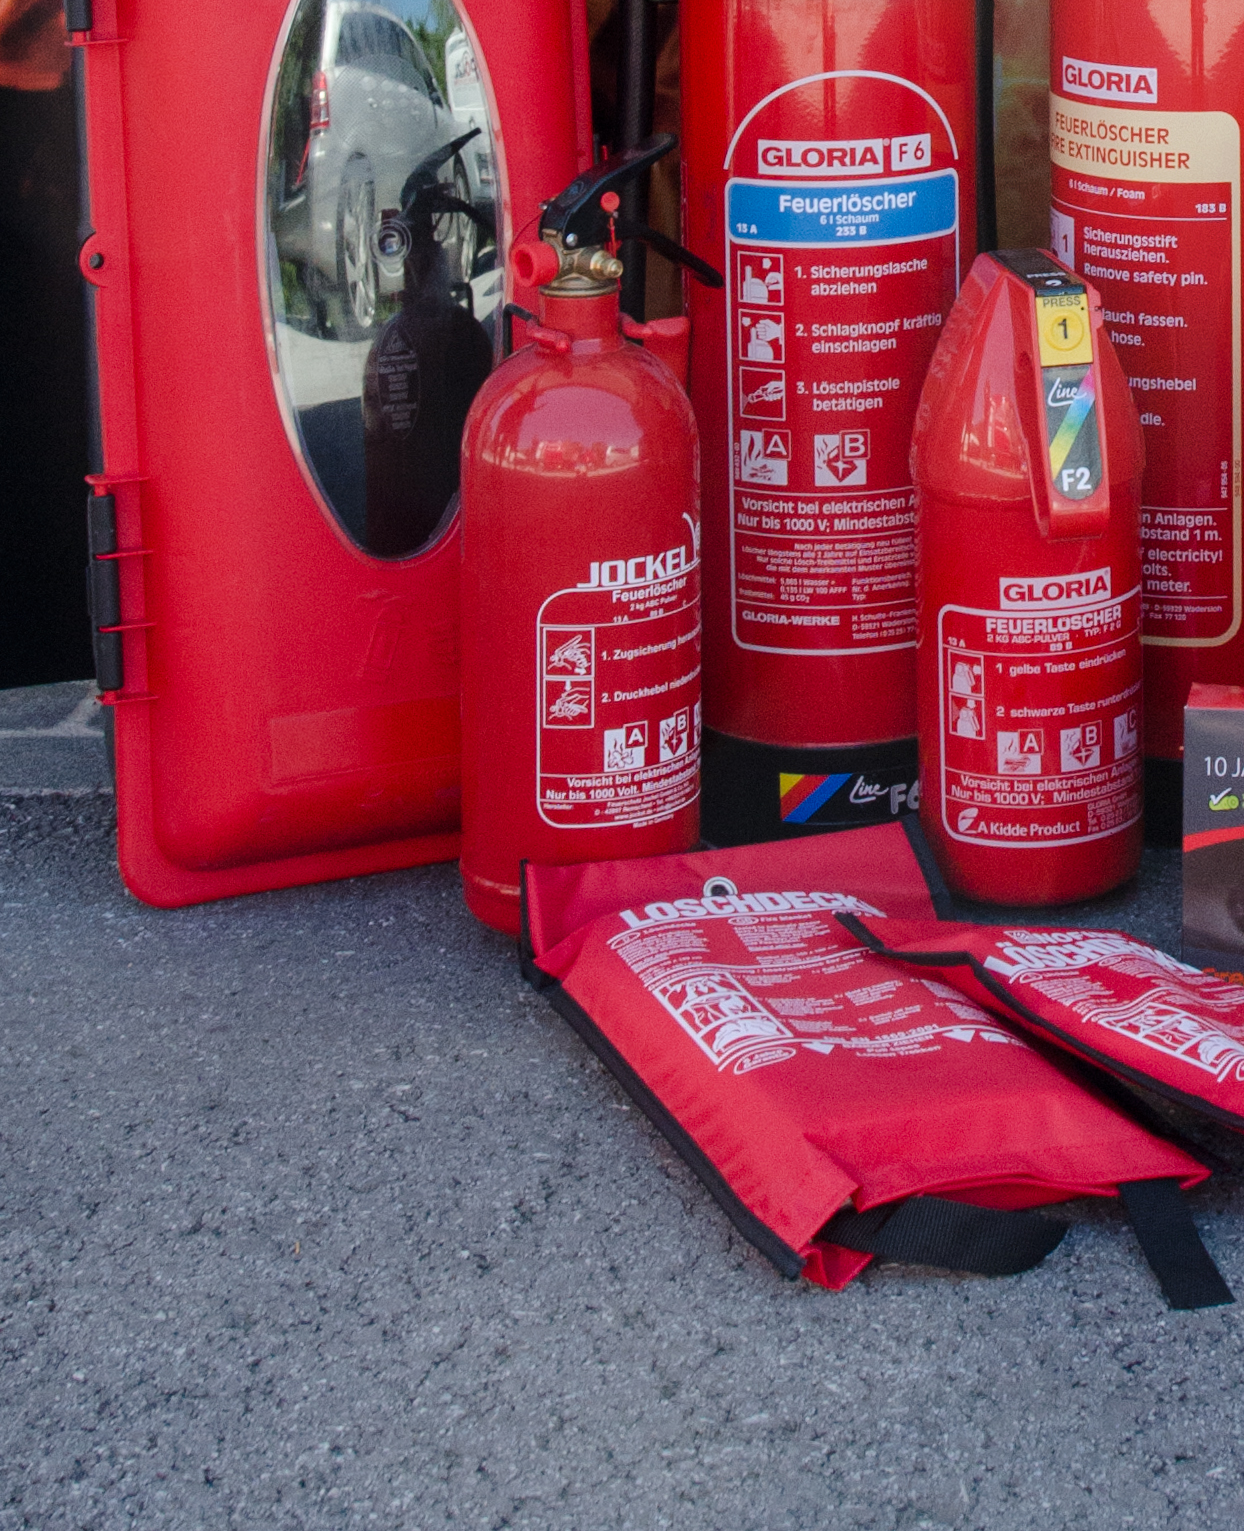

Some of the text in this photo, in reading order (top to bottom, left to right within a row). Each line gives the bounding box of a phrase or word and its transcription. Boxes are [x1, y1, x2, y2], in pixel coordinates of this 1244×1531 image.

[1064, 64, 1154, 95] GLORIA
[1055, 112, 1169, 145] FEUERLÖSCHER
[761, 145, 879, 168] GLORIA
[899, 140, 925, 162] F 6
[1068, 141, 1190, 169] EXTINGUISHER
[1078, 181, 1108, 196] Schaum
[1117, 187, 1145, 200] Foam
[778, 191, 917, 214] Feuerlöscher
[1219, 203, 1227, 213] B
[819, 213, 880, 225] 6 Schaum
[749, 224, 758, 235] A
[858, 225, 867, 236] B
[1083, 226, 1178, 249] Sicherungsstift
[1062, 234, 1068, 253] 1
[1083, 242, 1170, 264] herausziehen.
[794, 257, 929, 280] 1. Sicherungslasche
[1084, 262, 1208, 286] Remove safety pin.
[810, 281, 878, 297] abziehen
[1043, 296, 1081, 308] PRESS
[795, 312, 943, 339] 2. Schlagknopf kräftig
[1102, 308, 1188, 328] lauch fassen.
[1057, 318, 1068, 340] 1
[1111, 330, 1145, 346] hose.
[811, 336, 898, 355] einschlagen
[796, 376, 901, 397] 3. Löschpistole
[1048, 377, 1088, 407] Line
[1129, 376, 1197, 391] ngshebel
[812, 396, 884, 412] betätigen
[765, 437, 788, 457] A
[843, 433, 866, 457] B
[1062, 466, 1092, 491] F2
[741, 494, 906, 515] Vorsicht bei elektrischen
[737, 511, 916, 533] Nur bis 1000 V; Mindestabst
[1154, 512, 1218, 528] Anlagen.
[1192, 529, 1200, 541] 1
[1204, 530, 1223, 541] m.
[1147, 549, 1223, 564] electricity!
[577, 545, 692, 589] JOCKEL
[1142, 562, 1172, 576] olts.
[612, 576, 688, 604] Feuerlöscher
[1003, 574, 1109, 602] GLORIA
[1146, 579, 1192, 592] meter.
[741, 609, 841, 626] GLORIA-WERKE
[985, 604, 1122, 634] FEUERLÖSCHER
[958, 639, 966, 648] A
[1065, 641, 1073, 650] B
[987, 634, 993, 642] 2
[995, 634, 1010, 643] KG
[1011, 632, 1070, 643] ABC-PULVER
[601, 639, 677, 661] 1. Zugsicherung
[996, 662, 1003, 673] 1
[1009, 664, 1041, 677] gelbe
[1044, 663, 1076, 673] Taste
[601, 680, 669, 703] 2. Druckhebel
[996, 702, 1096, 718] 2 schwarze Taste
[676, 711, 688, 730] B
[628, 727, 644, 744] A
[1022, 734, 1040, 752] A
[1085, 726, 1098, 745] B
[1203, 756, 1228, 777] 10
[567, 775, 613, 788] Vorsicht
[615, 773, 632, 784] bei
[959, 771, 1109, 792] Vorsicht bei elektrischen
[546, 785, 640, 800] Nur bis 1000 Volt.
[850, 775, 920, 815] Line F6
[951, 785, 973, 799] Nur
[974, 788, 992, 802] bis
[993, 791, 1028, 805] 1000
[977, 820, 1081, 836] A Kidde Product
